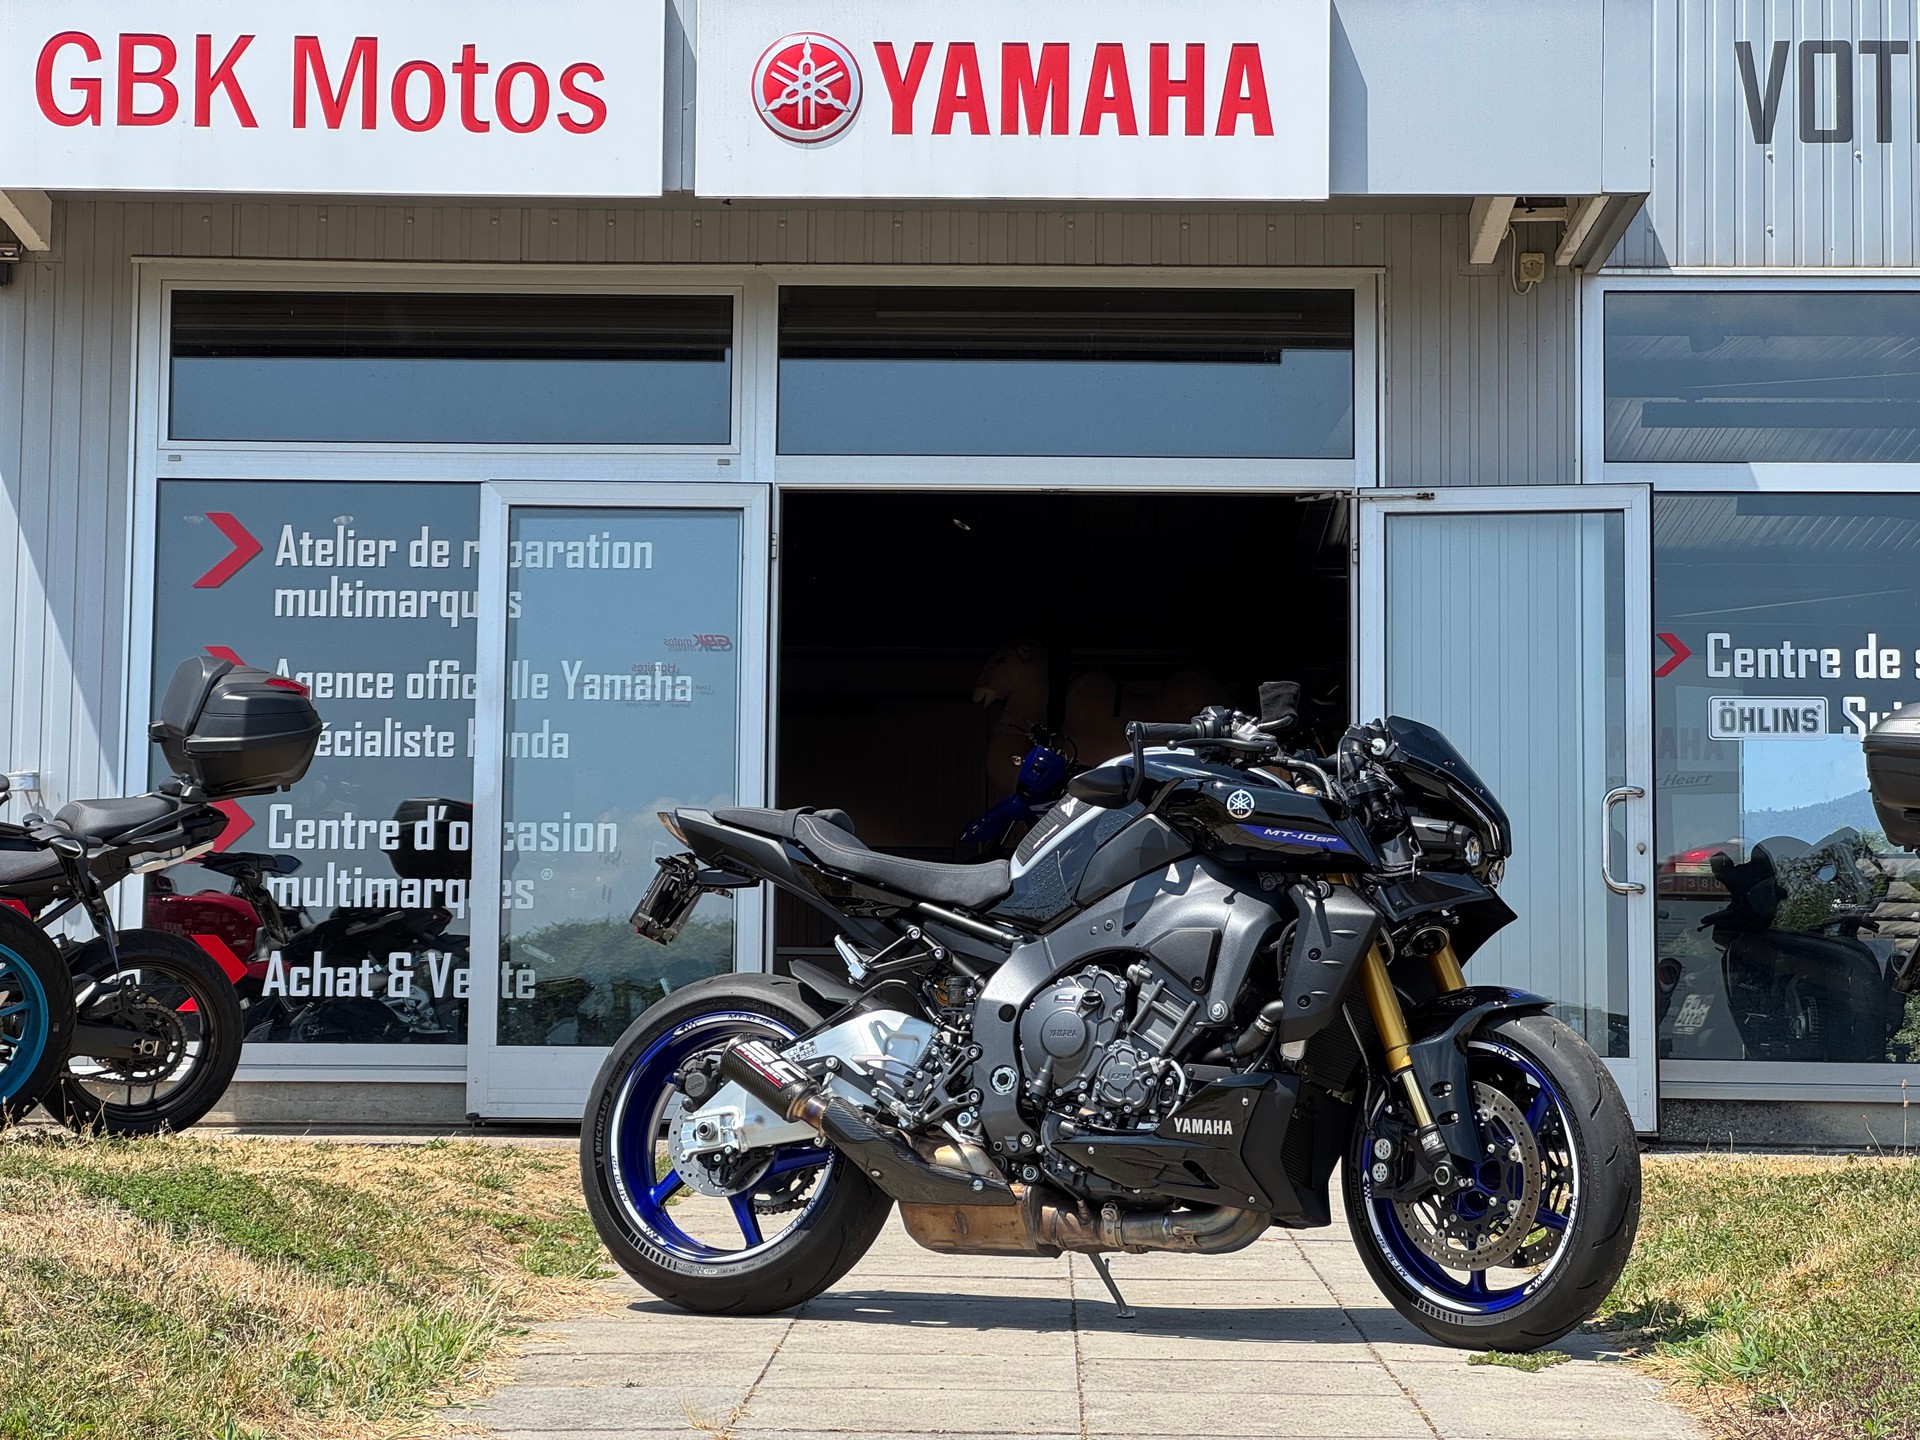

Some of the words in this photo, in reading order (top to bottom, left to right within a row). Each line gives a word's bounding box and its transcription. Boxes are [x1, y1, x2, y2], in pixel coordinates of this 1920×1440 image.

[35, 31, 259, 127] GBK
[292, 35, 608, 134] Motos
[873, 41, 1274, 136] YAMAHA
[1735, 40, 1920, 144] VOT
[275, 524, 397, 567] Atelier
[409, 526, 450, 567] de
[463, 531, 653, 569] rparation
[274, 575, 522, 628] multimarqus
[406, 660, 549, 699] officlle
[561, 660, 692, 701] Yamaha
[1707, 633, 1841, 679] Centre
[1855, 633, 1900, 679] de
[314, 717, 455, 757] écialiste
[269, 804, 399, 850] Centre
[414, 805, 617, 853] d'ocasion
[266, 862, 534, 919] multimarqs
[261, 950, 373, 998] Achat
[387, 952, 414, 998] &
[428, 952, 536, 999] Vete
[1174, 1118, 1233, 1135] YAMAHA
